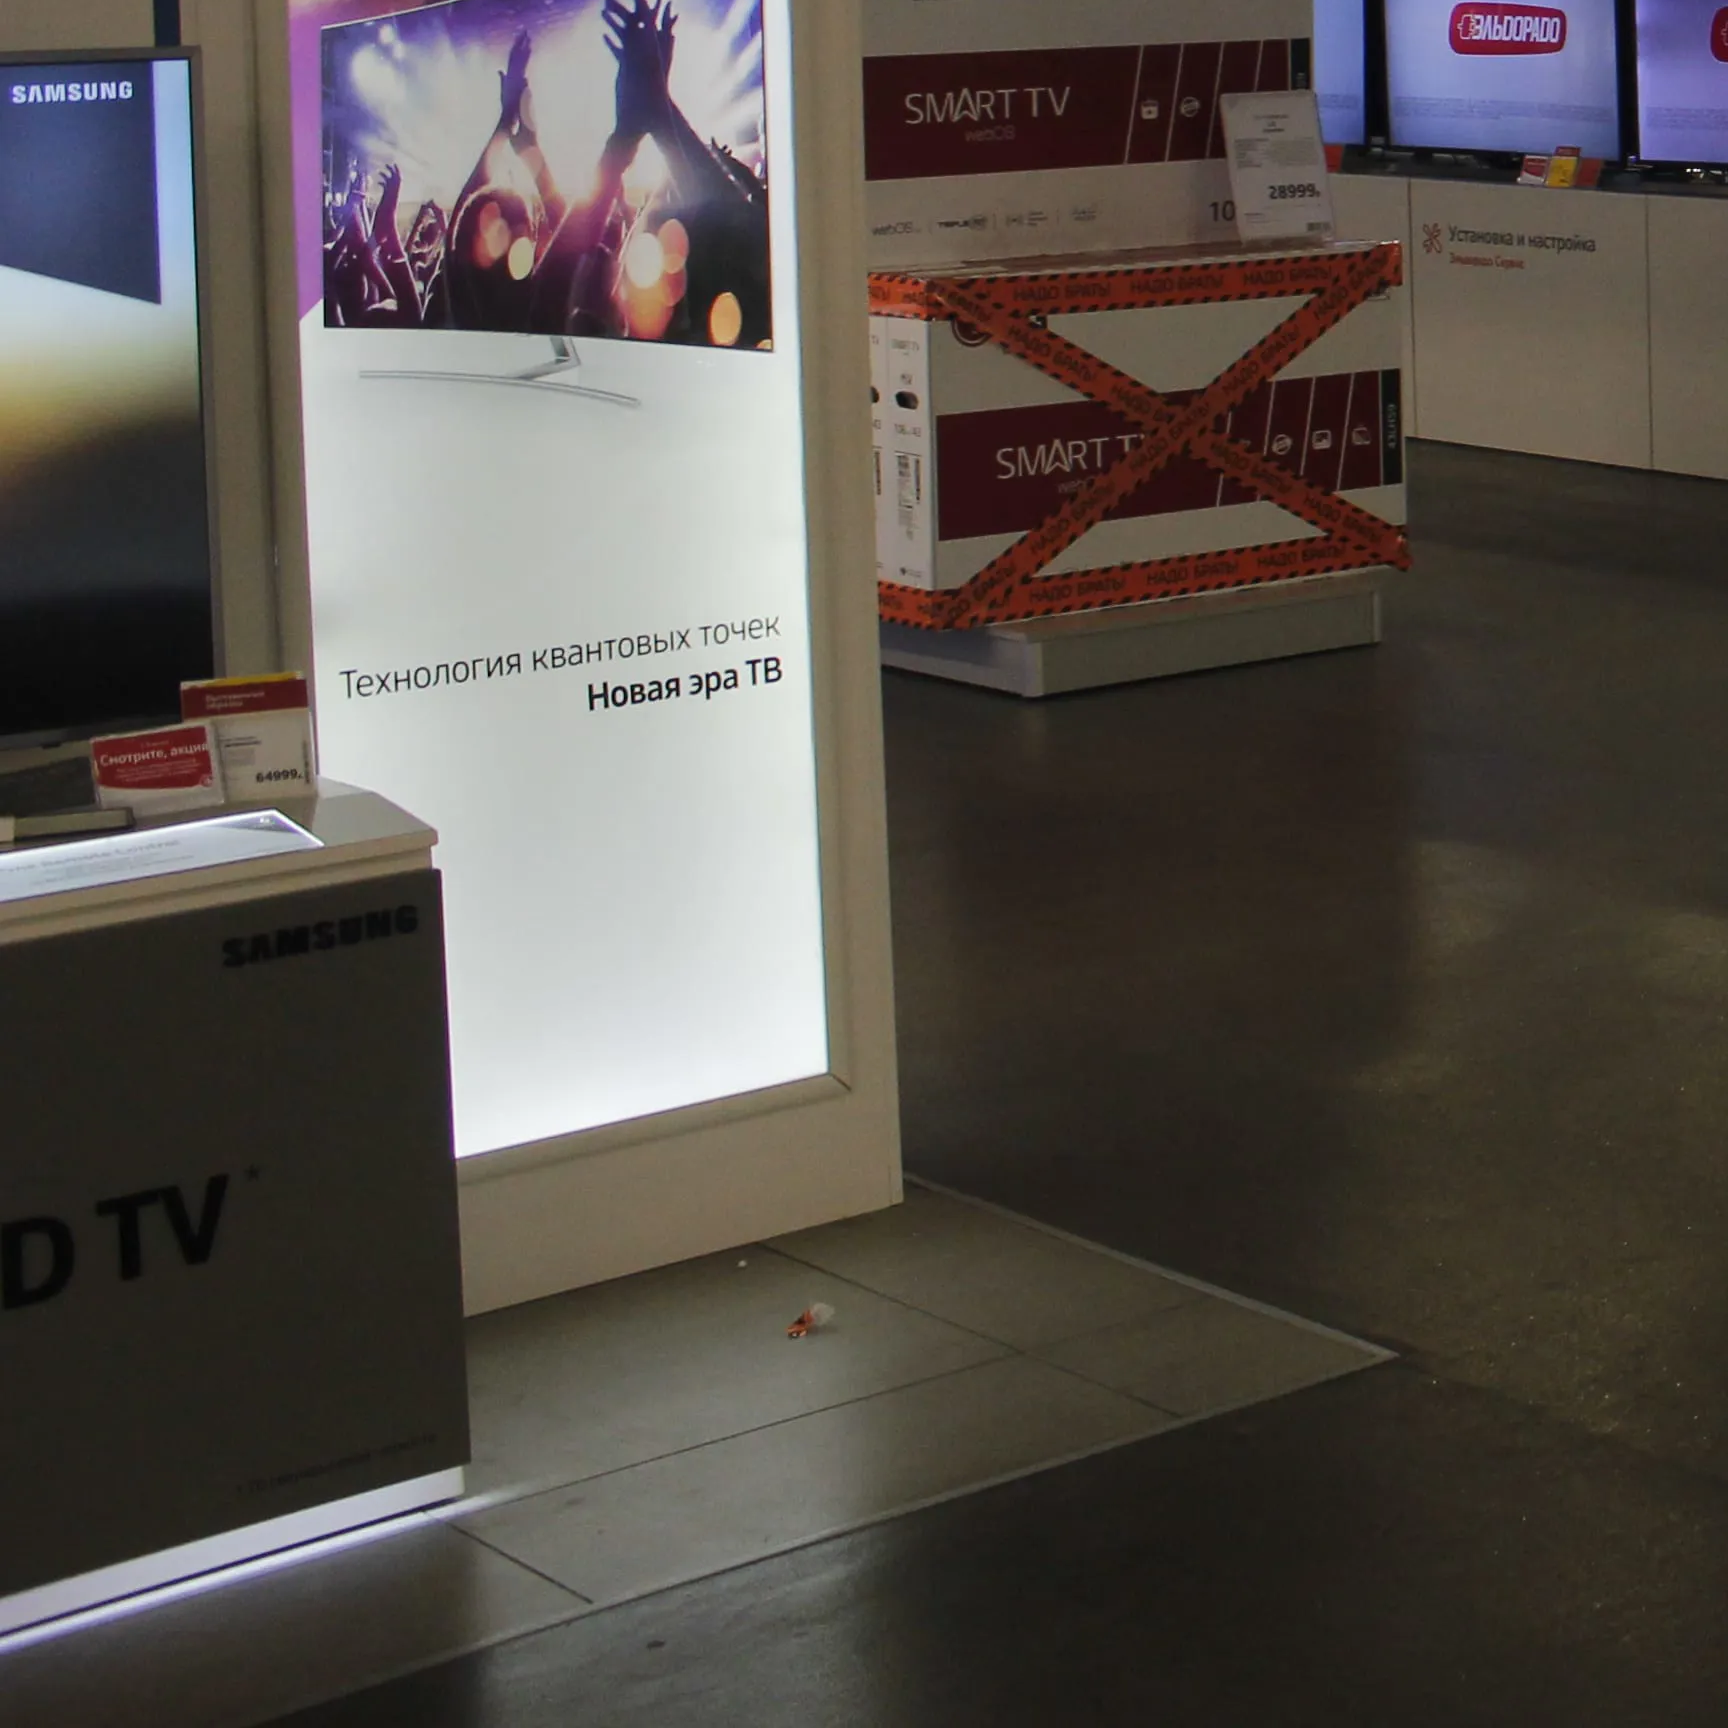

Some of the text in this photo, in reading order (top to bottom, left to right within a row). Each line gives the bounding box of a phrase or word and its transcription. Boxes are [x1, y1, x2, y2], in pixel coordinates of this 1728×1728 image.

[12, 81, 134, 104] SAMSUNG
[906, 86, 1072, 125] SMART TV
[1449, 223, 1598, 255] Установка и настройка
[995, 433, 1146, 480] SMART T
[339, 615, 784, 700] Технология квантовых точек
[587, 656, 785, 713] Новая эра ТВ
[100, 745, 168, 768] Смотрите,
[170, 739, 210, 759] акция
[221, 903, 420, 970] SAMSUNG
[95, 1172, 231, 1283] TV
